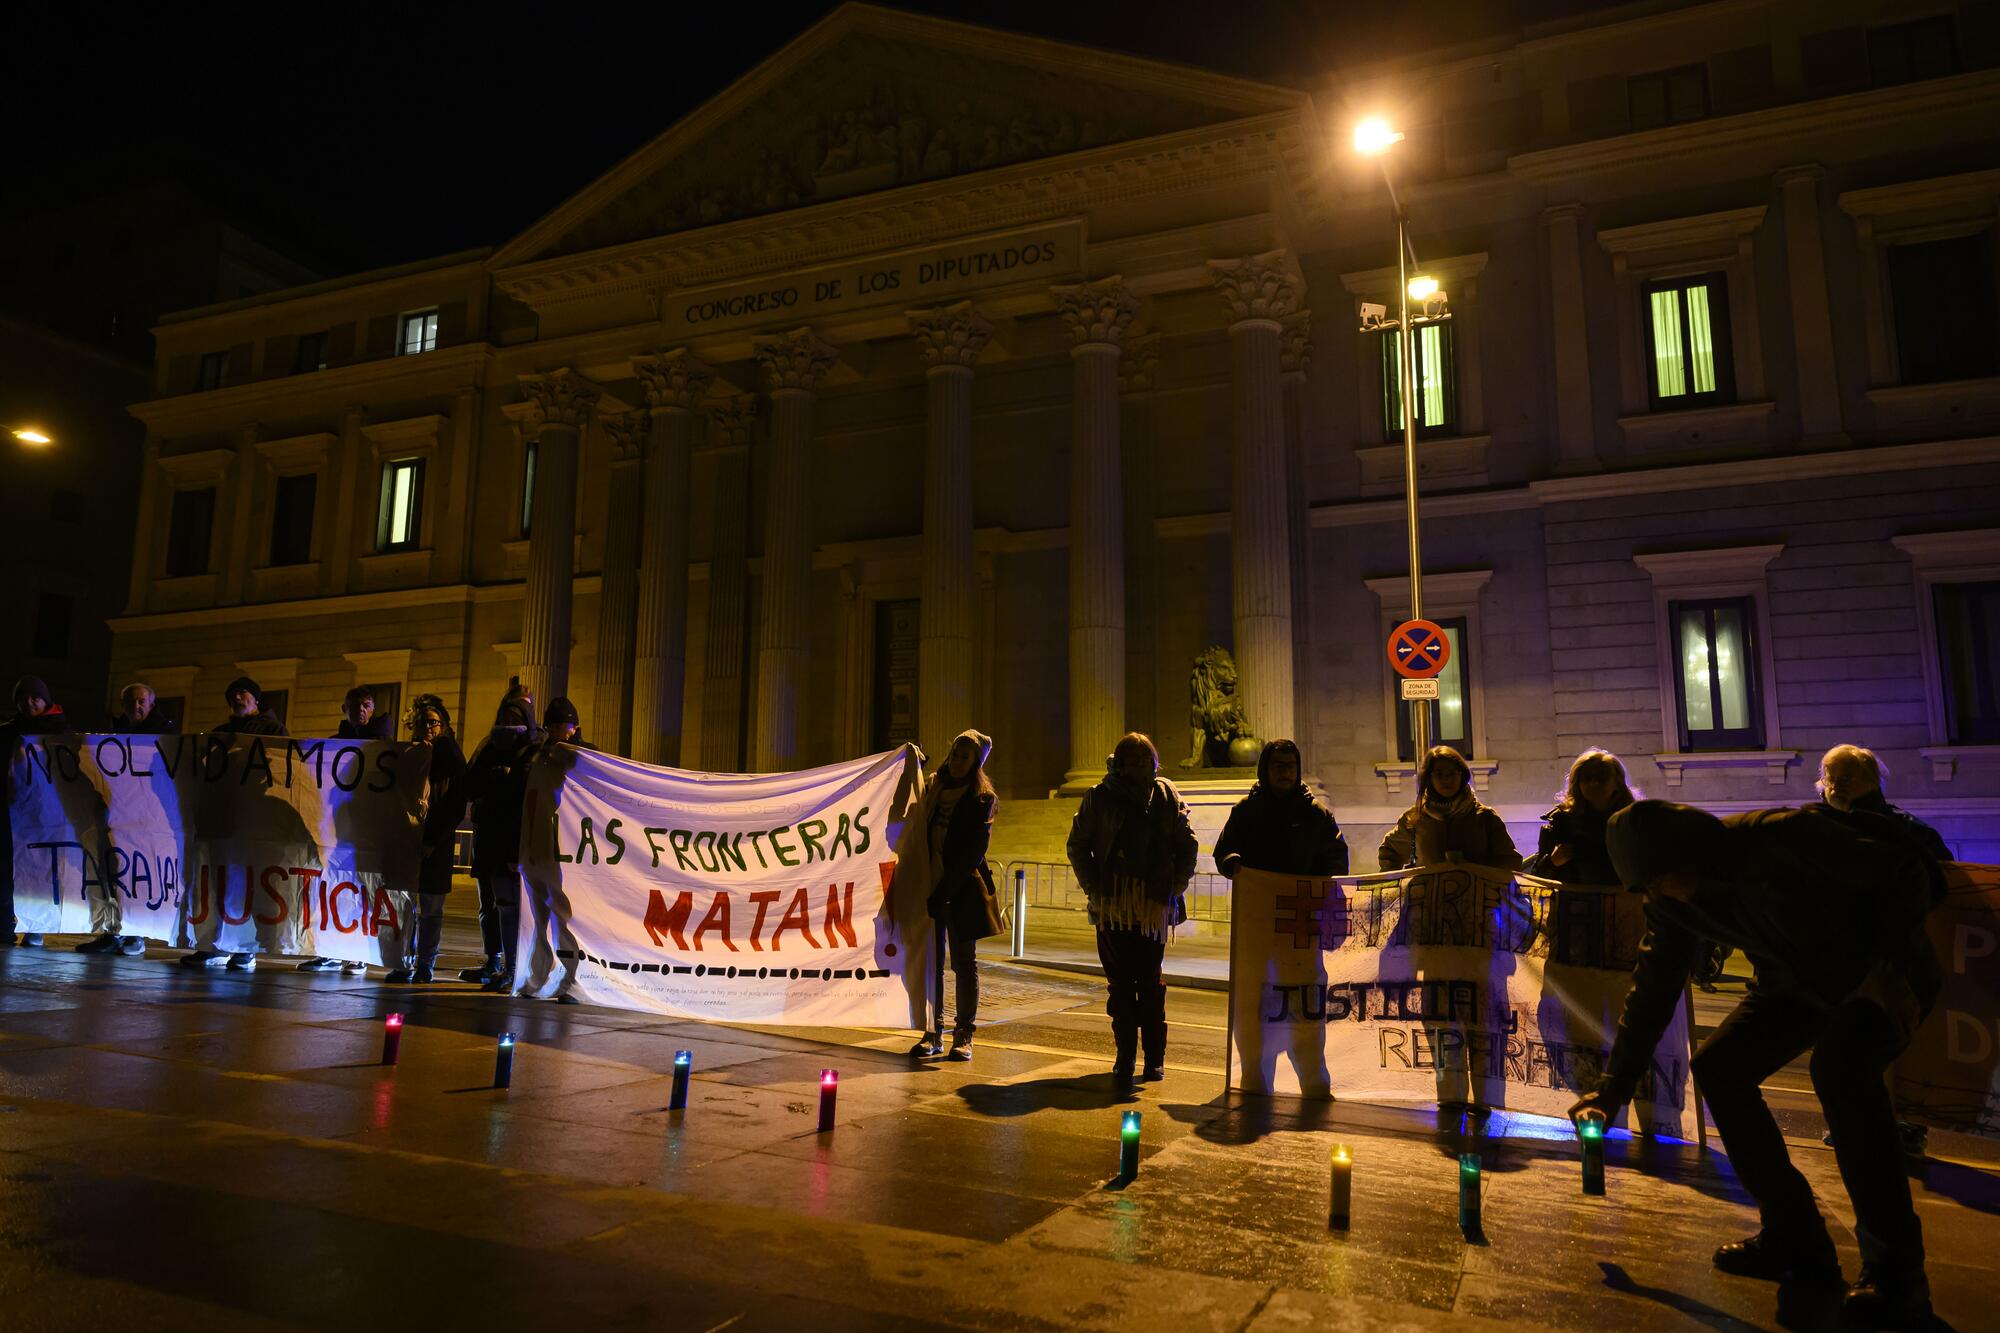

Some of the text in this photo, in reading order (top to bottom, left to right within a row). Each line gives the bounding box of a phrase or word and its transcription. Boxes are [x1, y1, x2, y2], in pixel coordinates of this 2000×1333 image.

[685, 241, 1057, 324] CONGRESO DE LOS DIPUTADOS
[26, 736, 399, 793] NO OLVIDAMOS
[552, 812, 627, 865] LAS
[643, 806, 871, 873] FRONTERAS
[187, 864, 400, 939] JUSTICIA
[1267, 980, 1478, 1023] JUSTICIA
